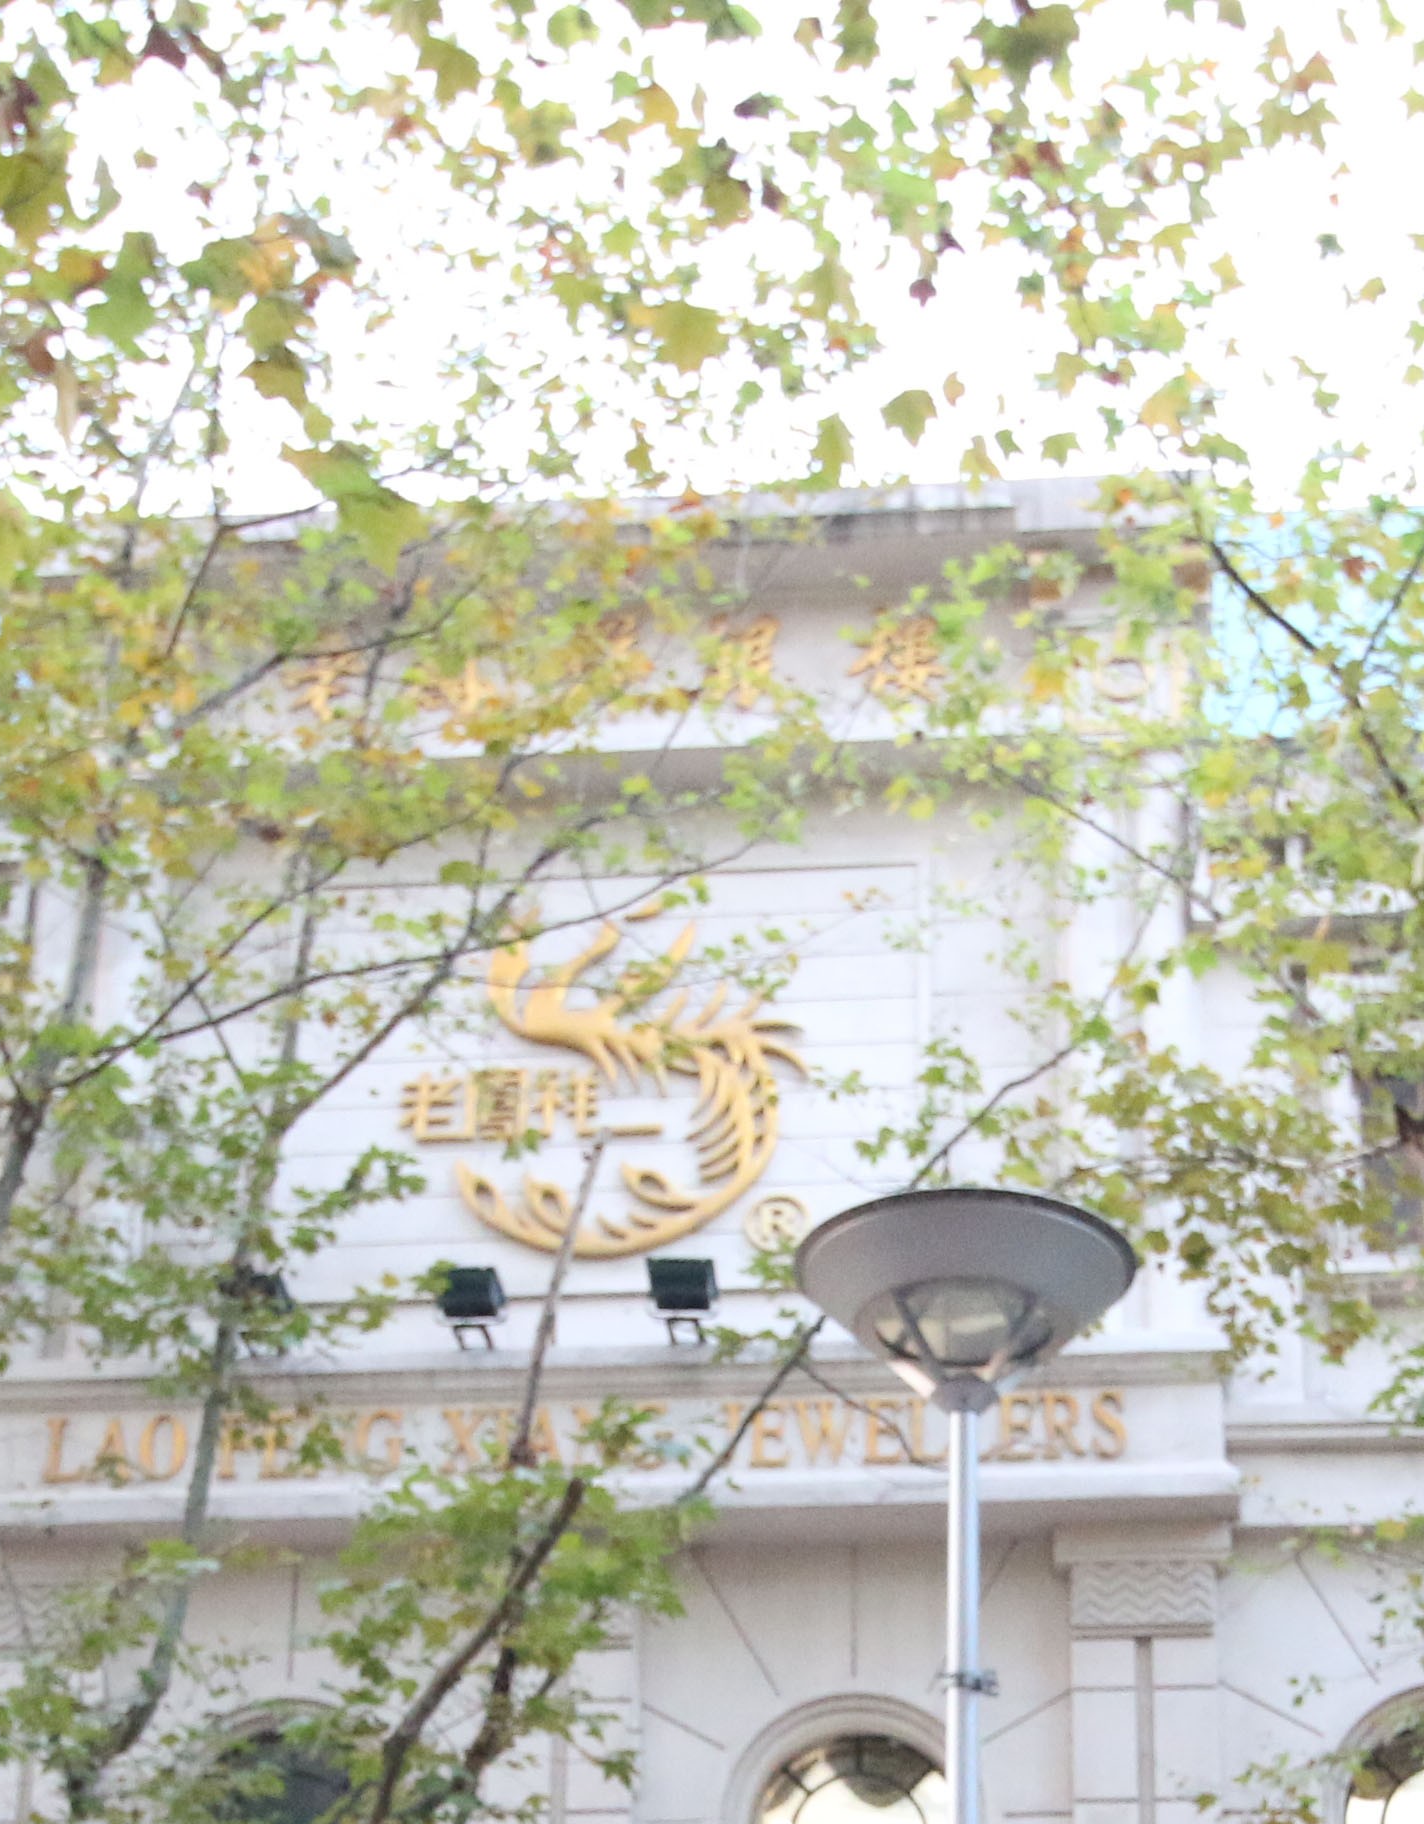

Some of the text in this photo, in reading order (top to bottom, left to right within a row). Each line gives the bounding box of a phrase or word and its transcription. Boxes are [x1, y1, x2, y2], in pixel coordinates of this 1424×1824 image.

[40, 1414, 189, 1483] LAO
[214, 1408, 406, 1482] FEG
[719, 1390, 1130, 1470] JEWELERS
